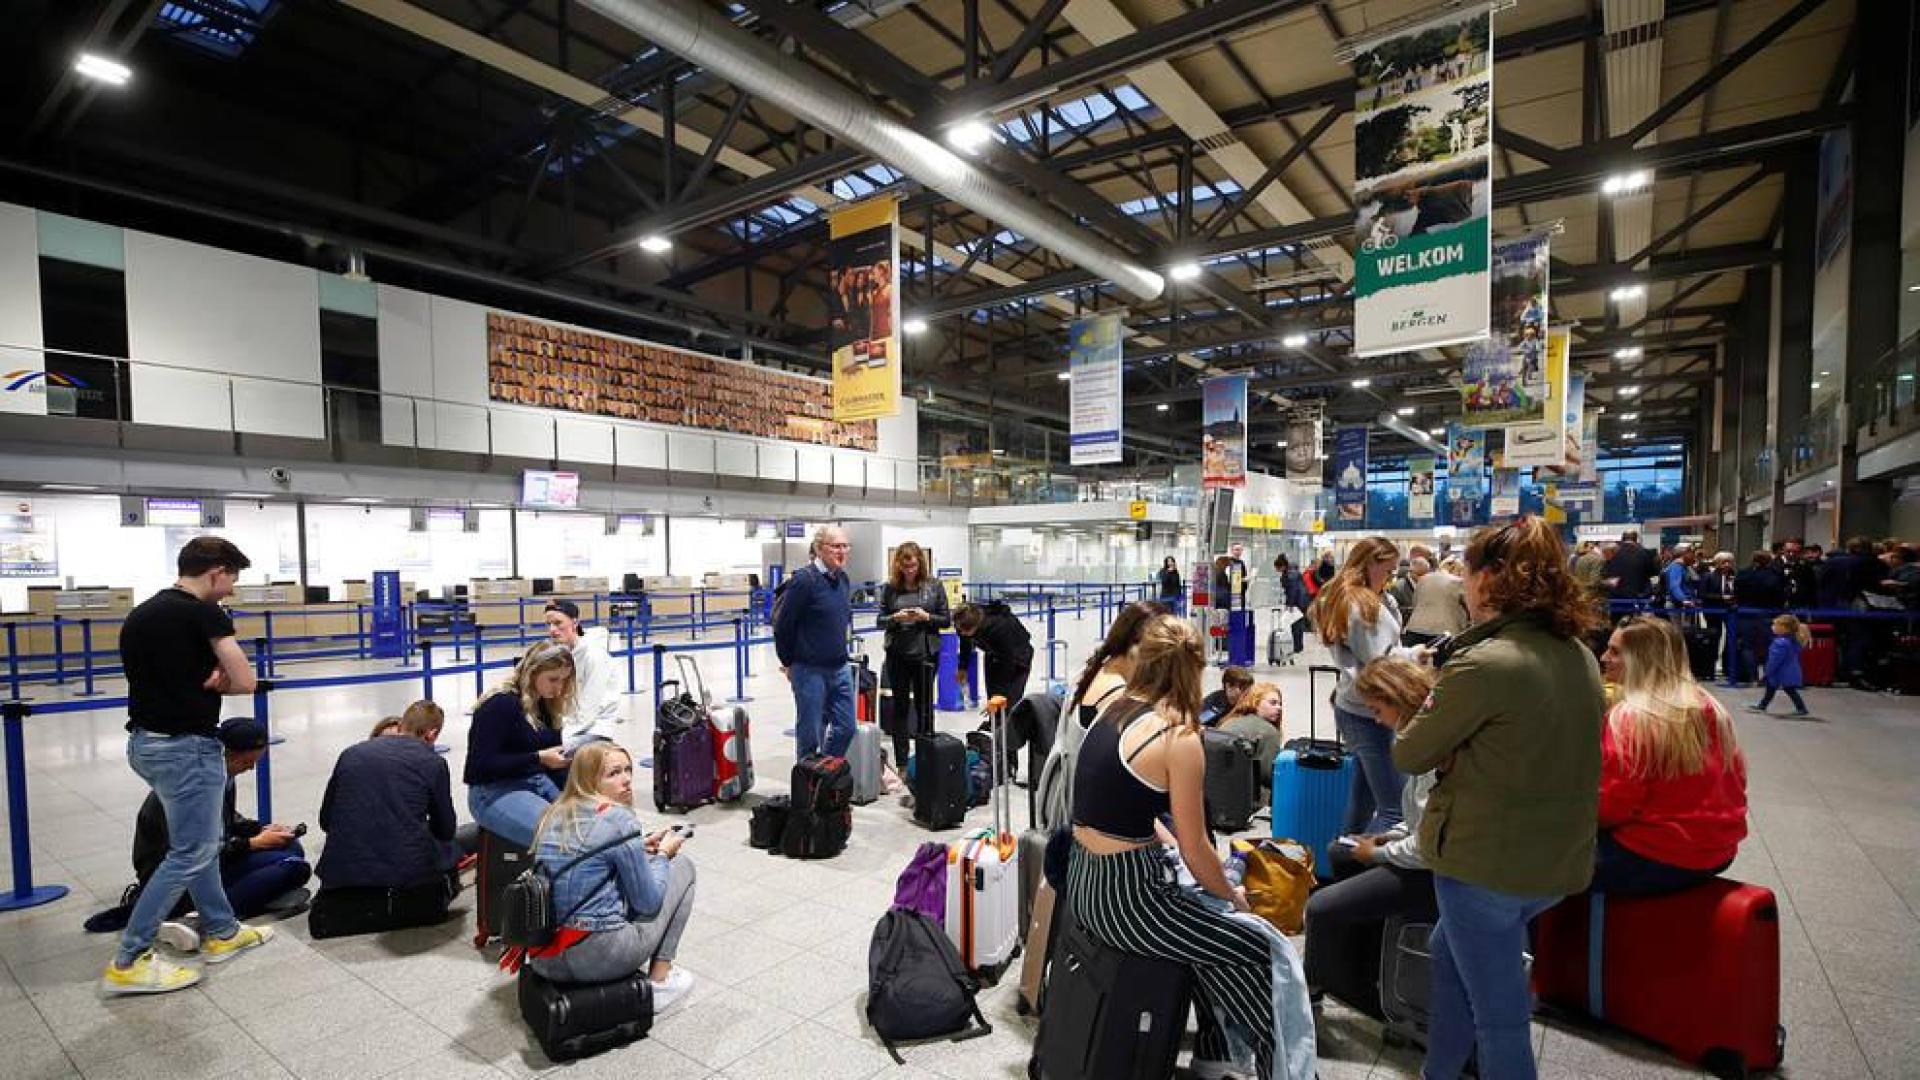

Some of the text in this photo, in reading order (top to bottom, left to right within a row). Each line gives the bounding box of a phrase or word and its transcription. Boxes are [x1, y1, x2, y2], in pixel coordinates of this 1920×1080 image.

[1377, 243, 1464, 276] WELKOM
[1391, 313, 1448, 331] BERGEN
[208, 515, 220, 525] 10
